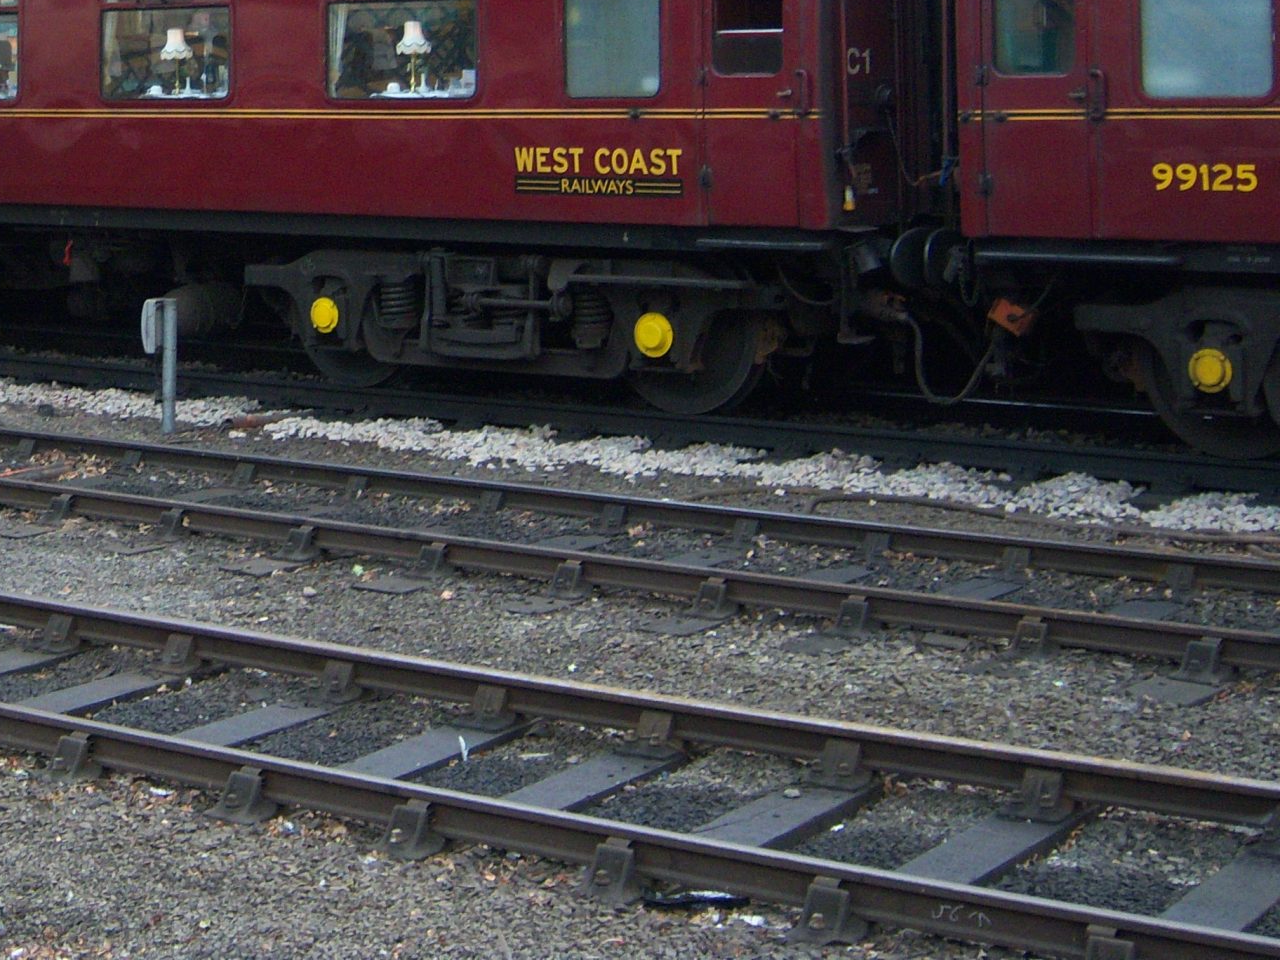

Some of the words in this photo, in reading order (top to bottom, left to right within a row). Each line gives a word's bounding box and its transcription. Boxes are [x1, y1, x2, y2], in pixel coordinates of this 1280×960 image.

[847, 47, 871, 75] C1
[514, 146, 584, 174] WEST
[594, 147, 683, 176] COAST
[560, 178, 634, 195] RAILWAYS
[1152, 163, 1258, 192] 99125
